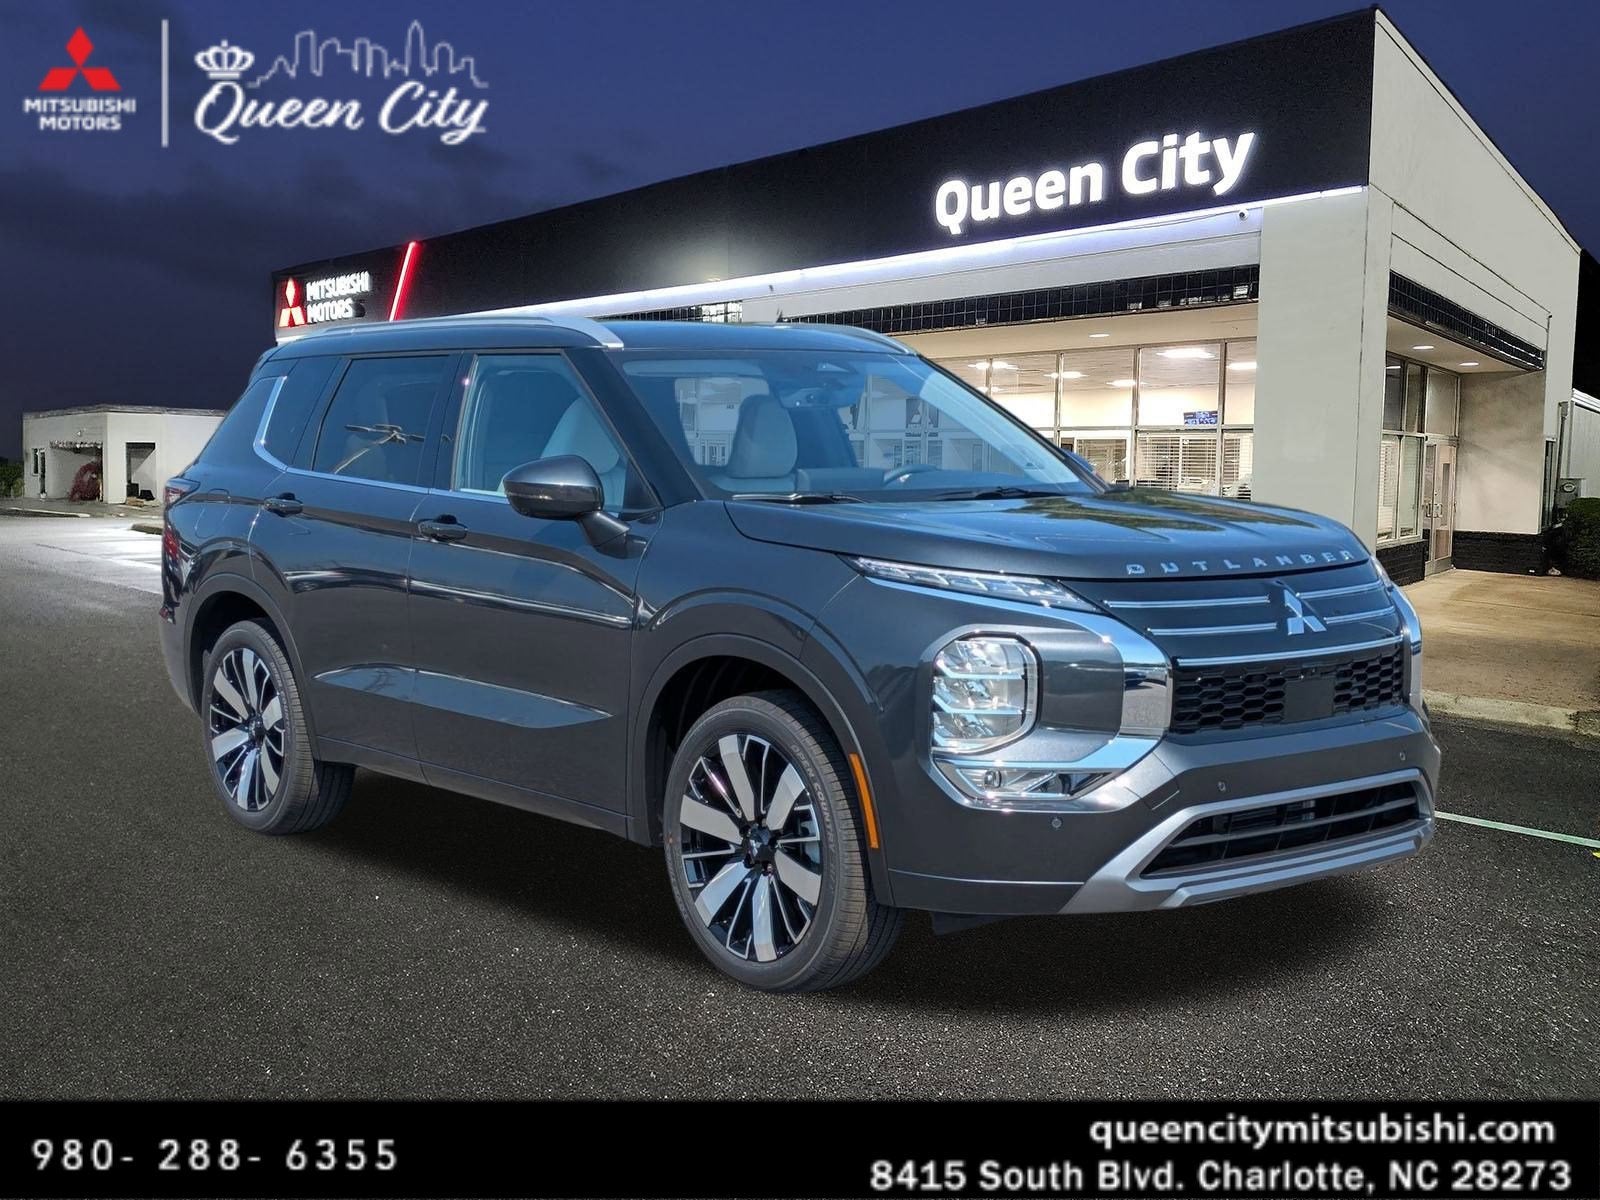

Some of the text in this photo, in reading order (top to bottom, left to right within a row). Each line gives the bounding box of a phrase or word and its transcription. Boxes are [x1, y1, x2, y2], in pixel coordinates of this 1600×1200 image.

[935, 131, 1256, 235] Queen City
[305, 271, 370, 302] MITSUBISHI
[306, 298, 354, 325] MOTORS
[1126, 549, 1354, 576] OUTLANDER
